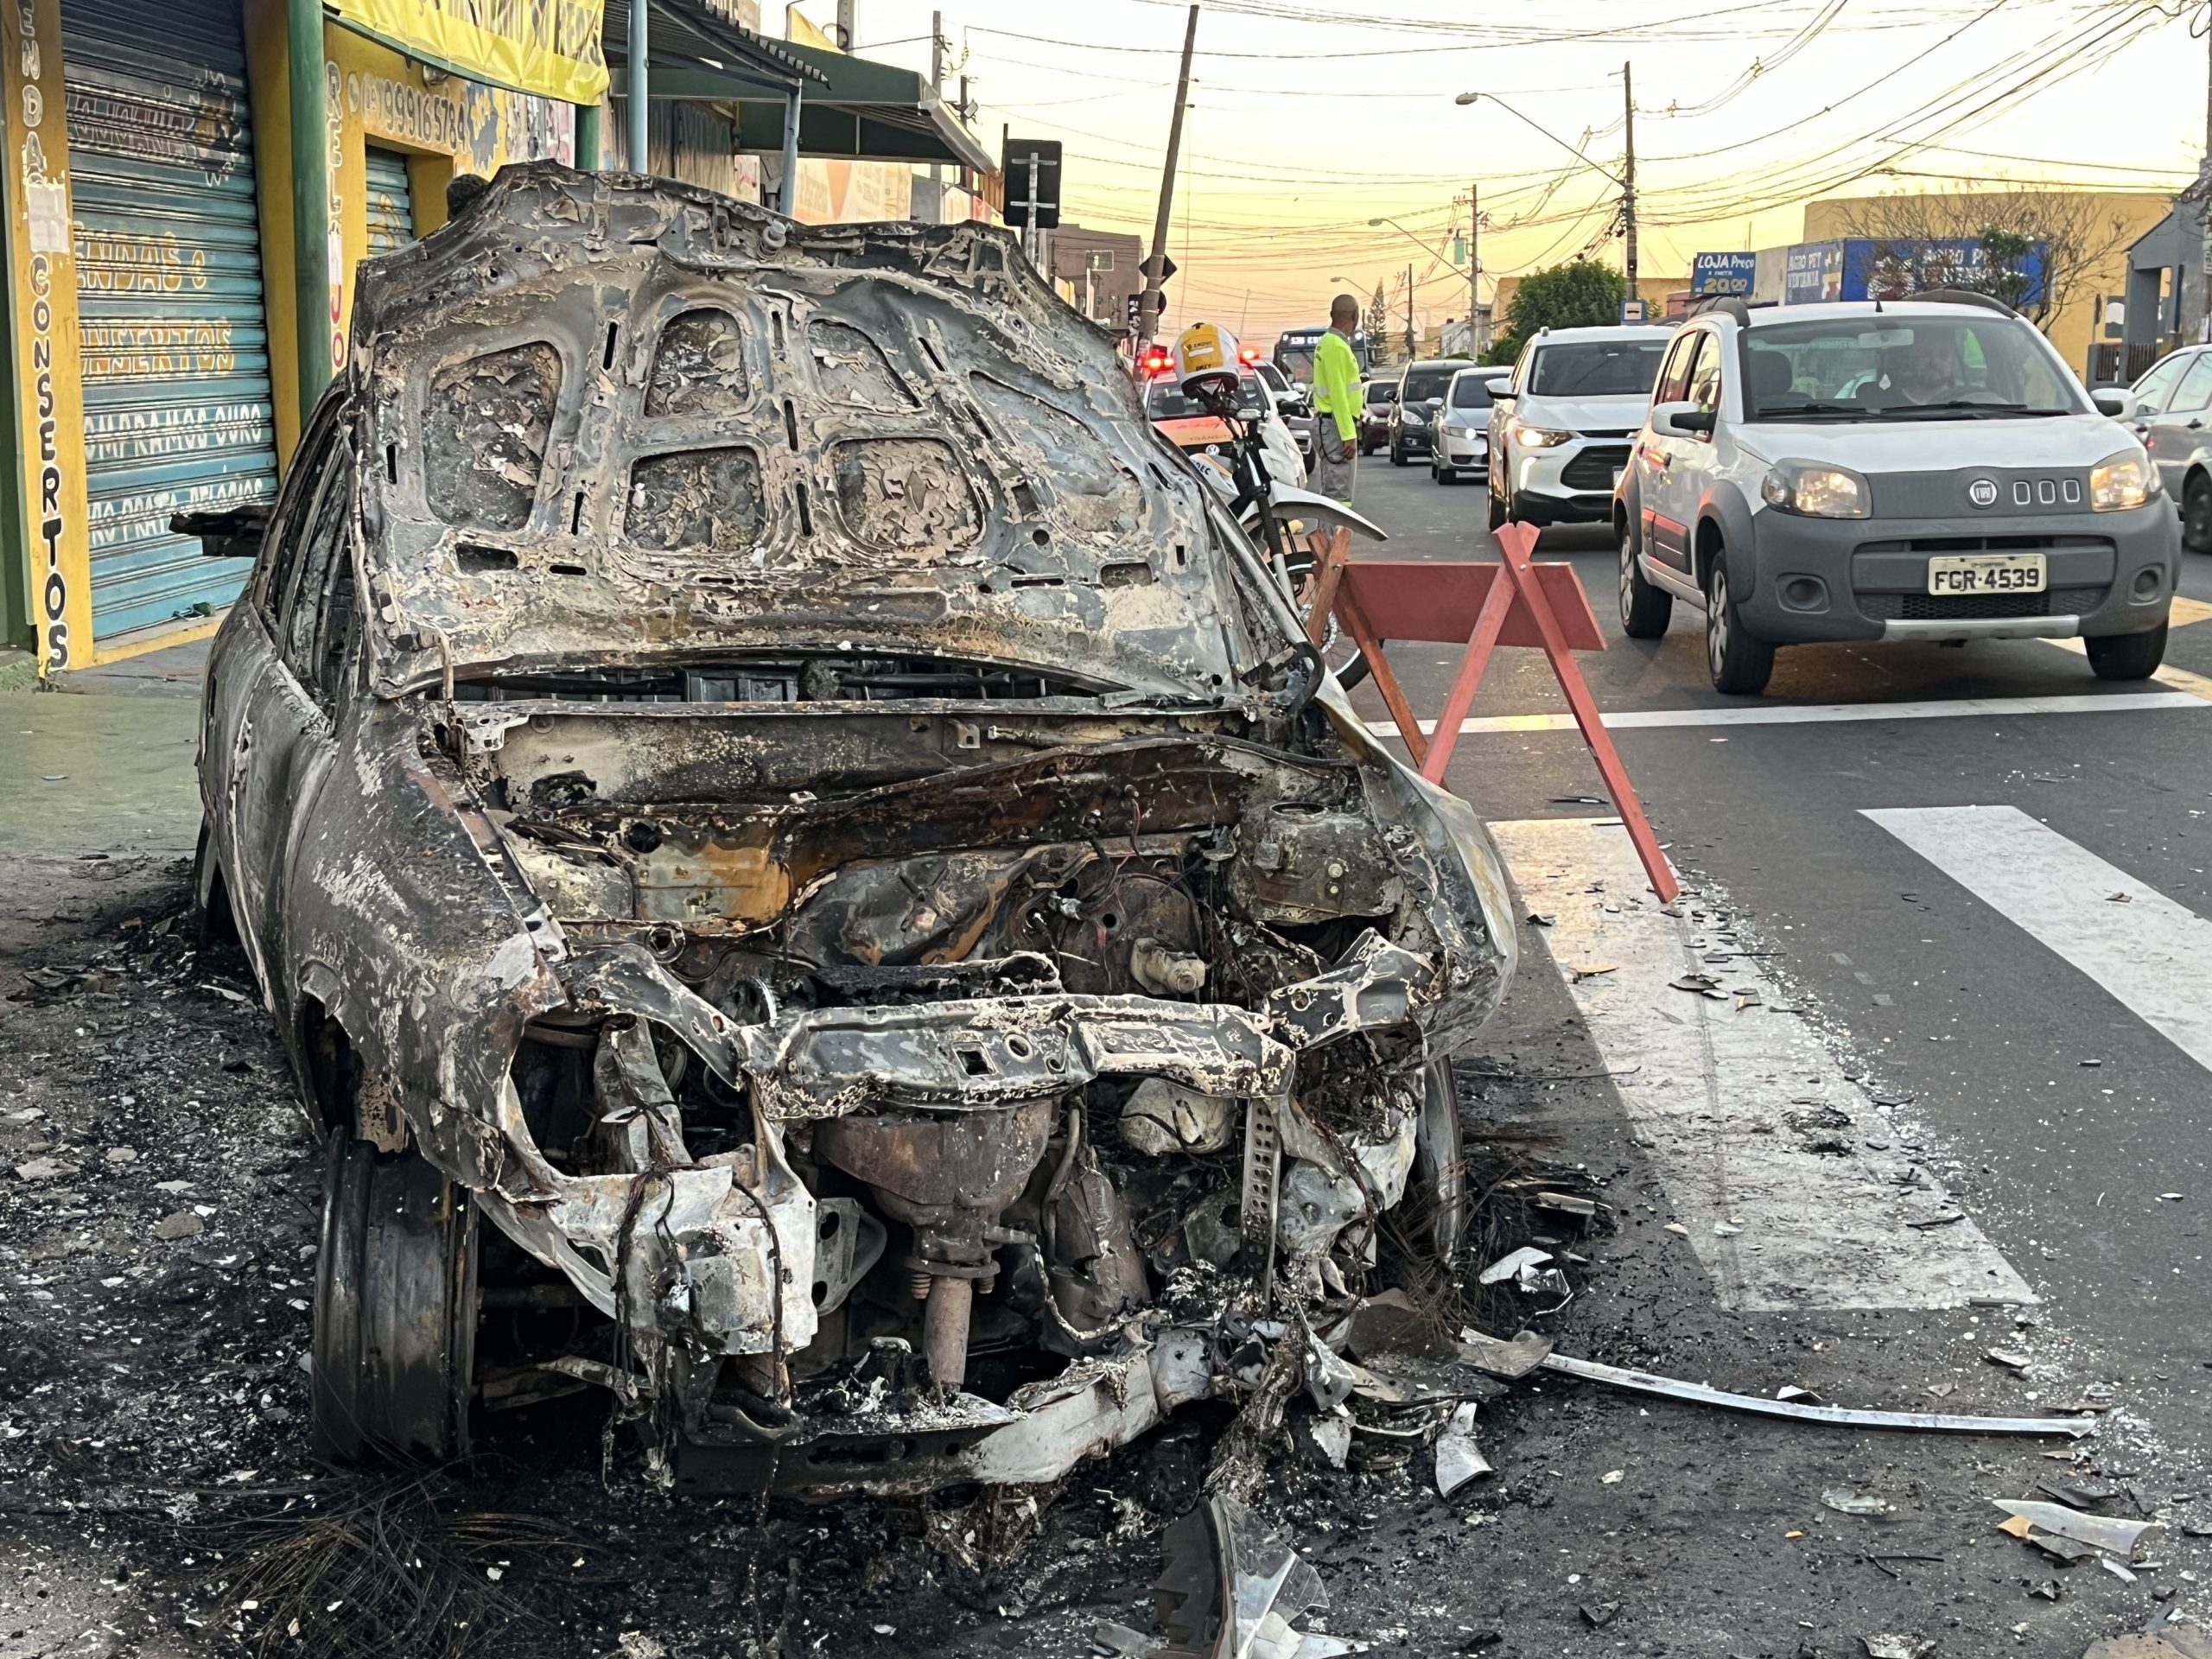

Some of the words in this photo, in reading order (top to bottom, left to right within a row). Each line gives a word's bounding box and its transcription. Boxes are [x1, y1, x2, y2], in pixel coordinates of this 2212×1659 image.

[1698, 254, 1729, 269] LOJA
[214, 403, 262, 446] OURO
[29, 254, 69, 671] CONSERTOS
